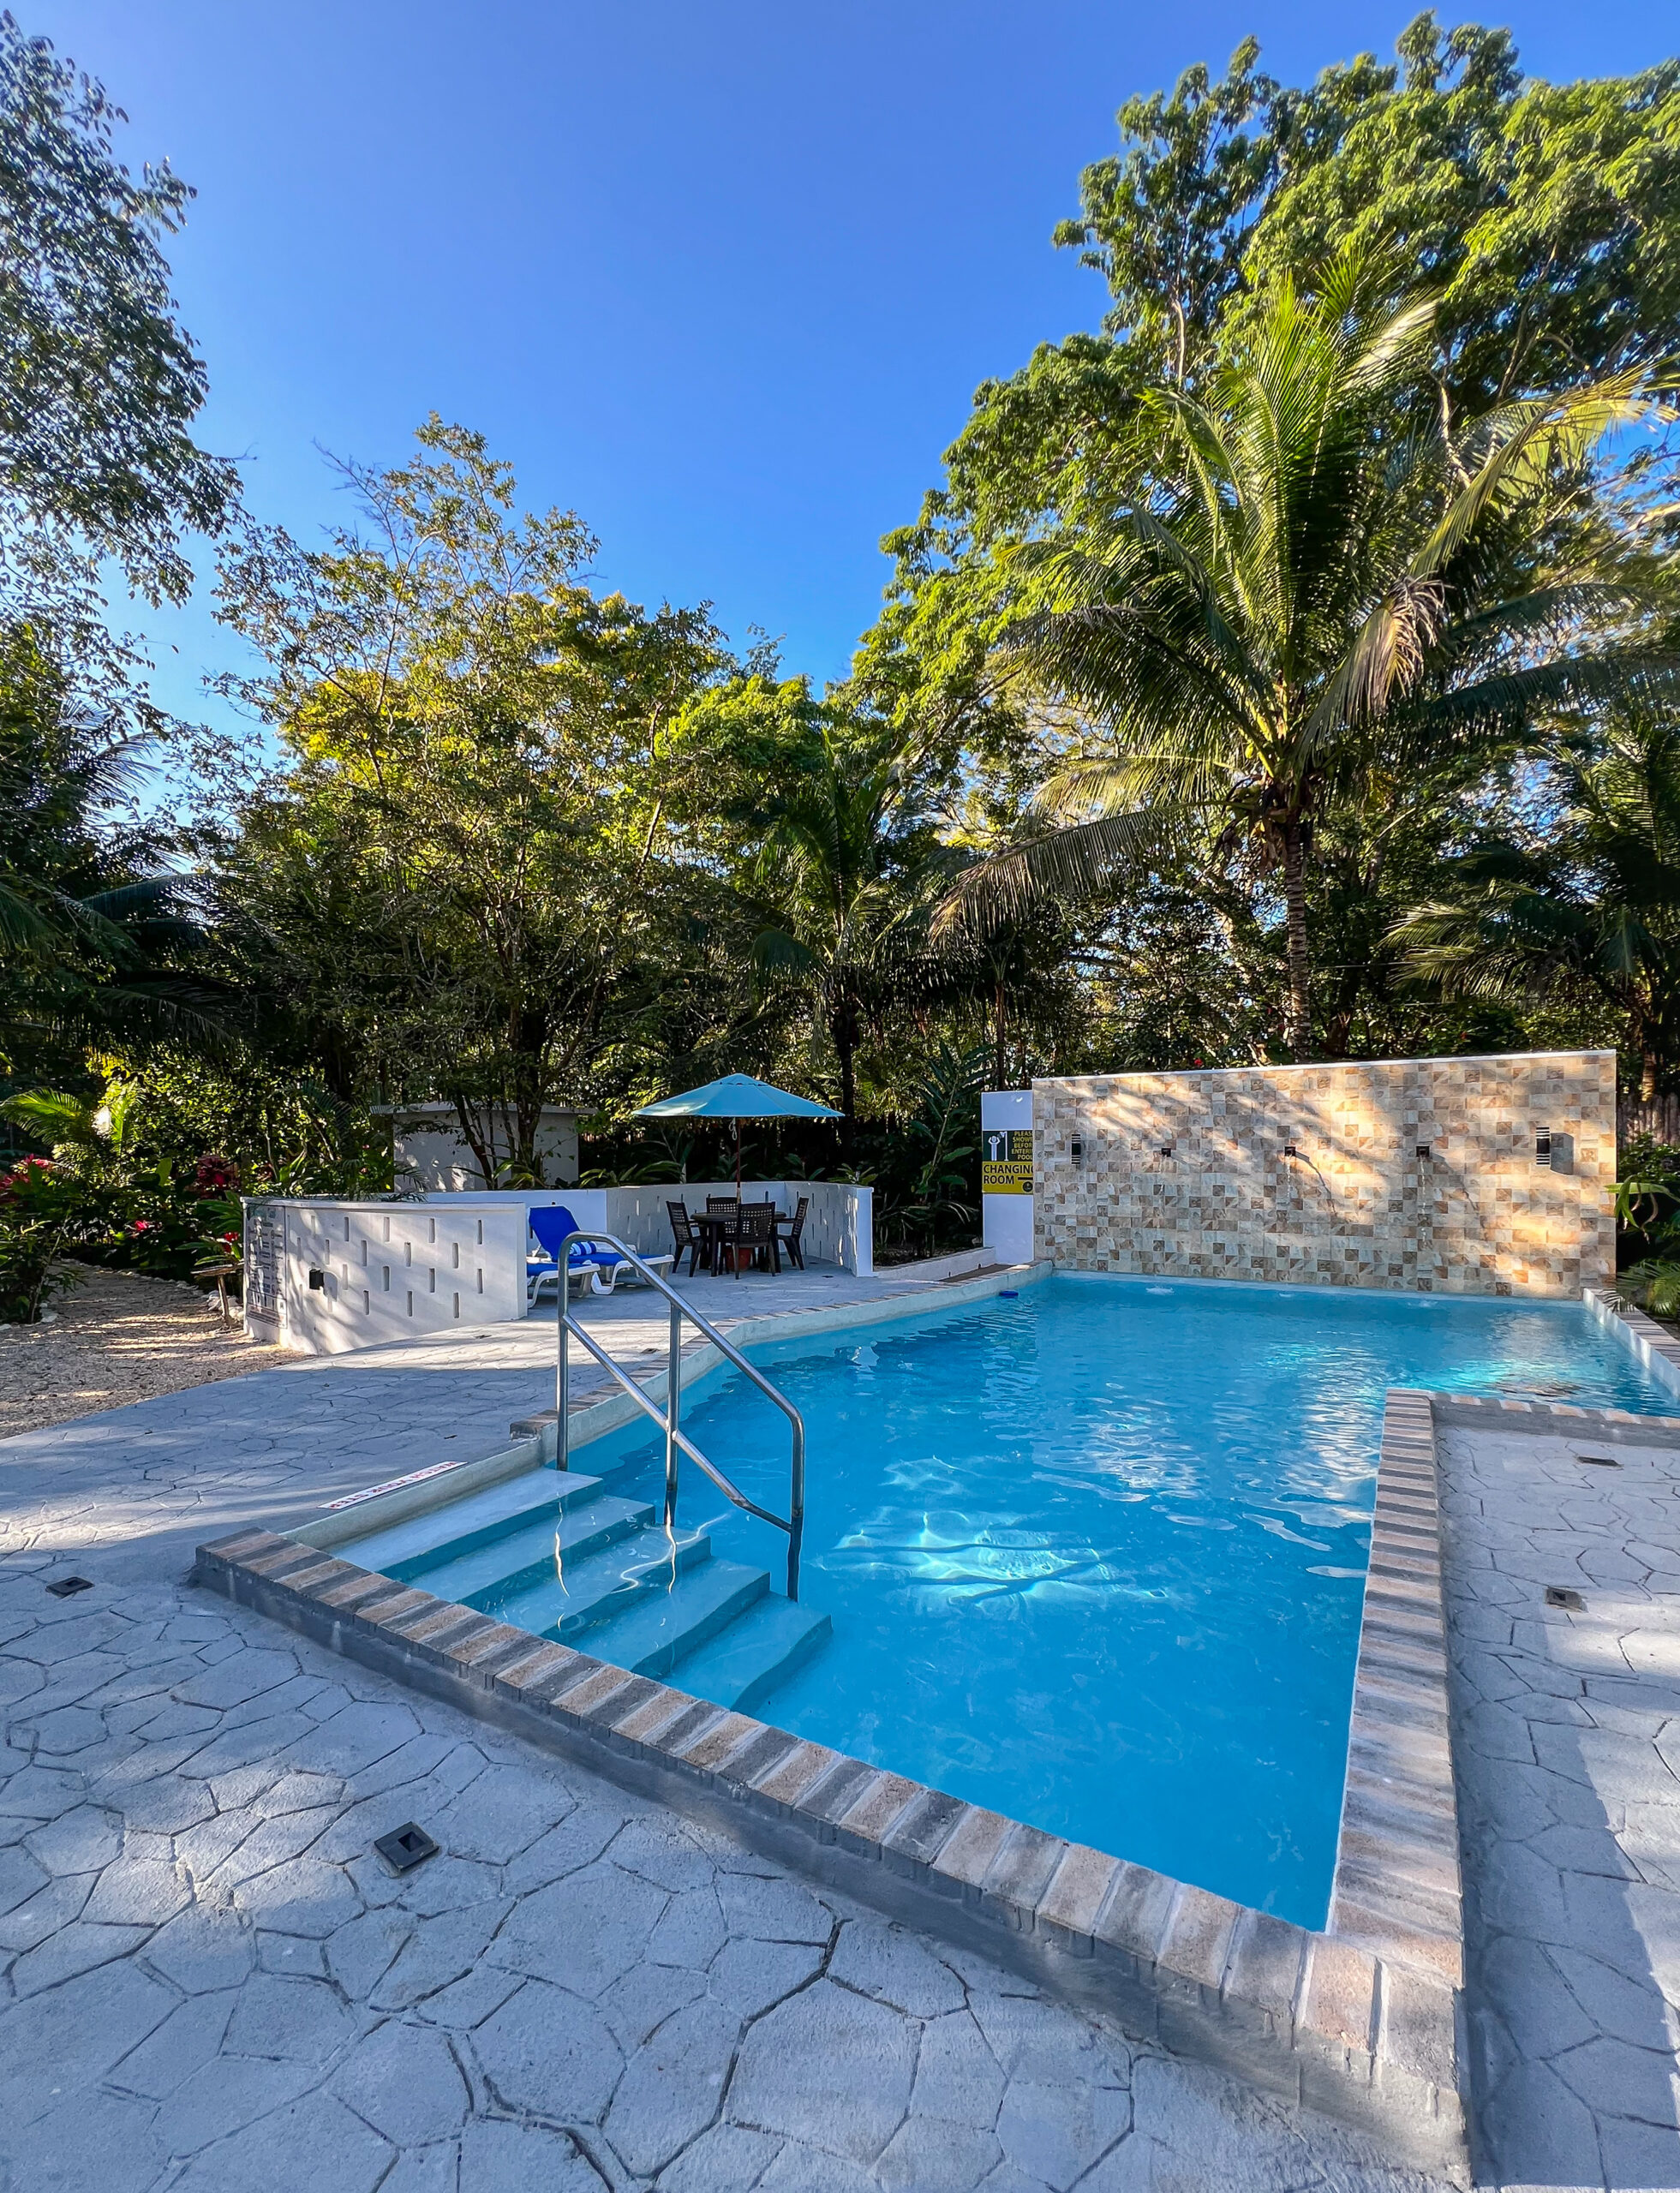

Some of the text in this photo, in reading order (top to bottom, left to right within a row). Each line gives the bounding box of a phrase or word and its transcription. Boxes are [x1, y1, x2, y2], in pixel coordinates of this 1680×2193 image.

[983, 1175, 1014, 1184] ROOM
[367, 1479, 412, 1493] YOUR
[329, 1493, 369, 1509] STEP
